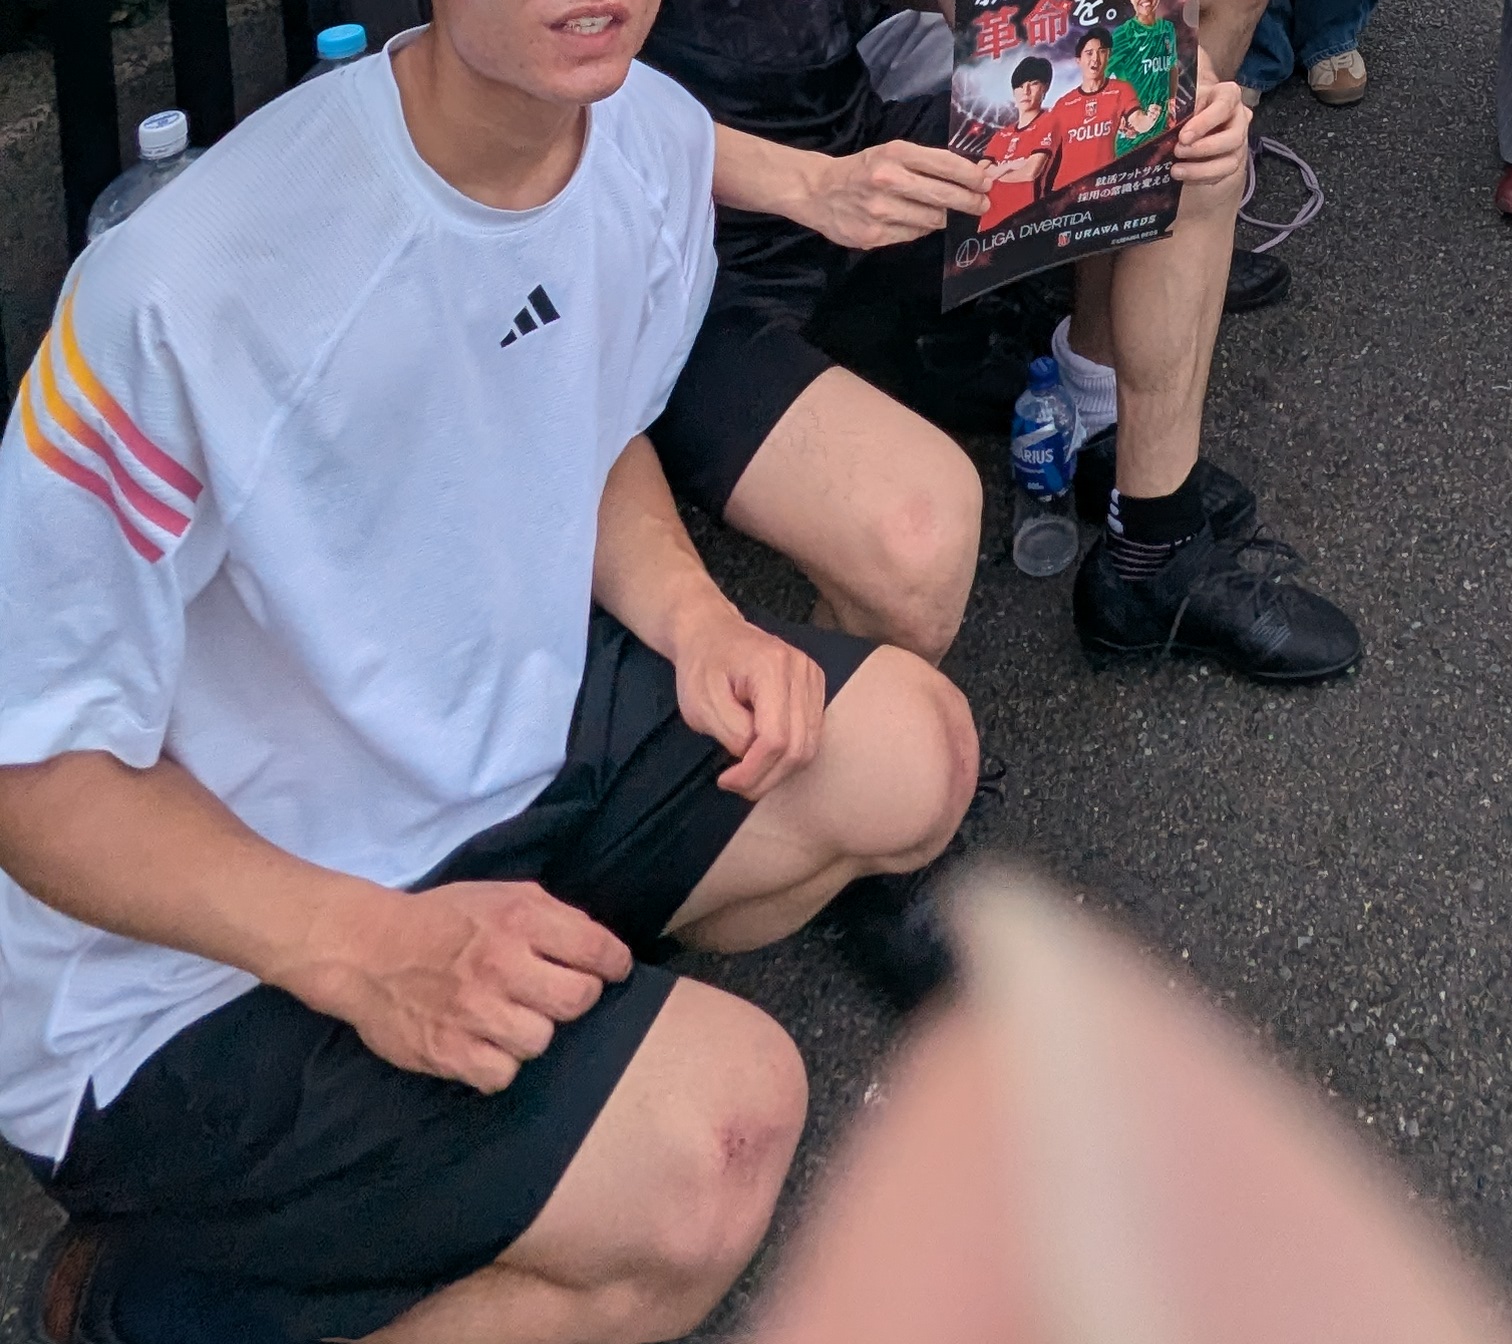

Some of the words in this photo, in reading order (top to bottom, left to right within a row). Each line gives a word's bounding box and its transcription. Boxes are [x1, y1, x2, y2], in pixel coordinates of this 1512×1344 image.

[1068, 120, 1113, 143] POLUS
[1074, 223, 1120, 242] URAWA
[1123, 214, 1158, 230] REDS
